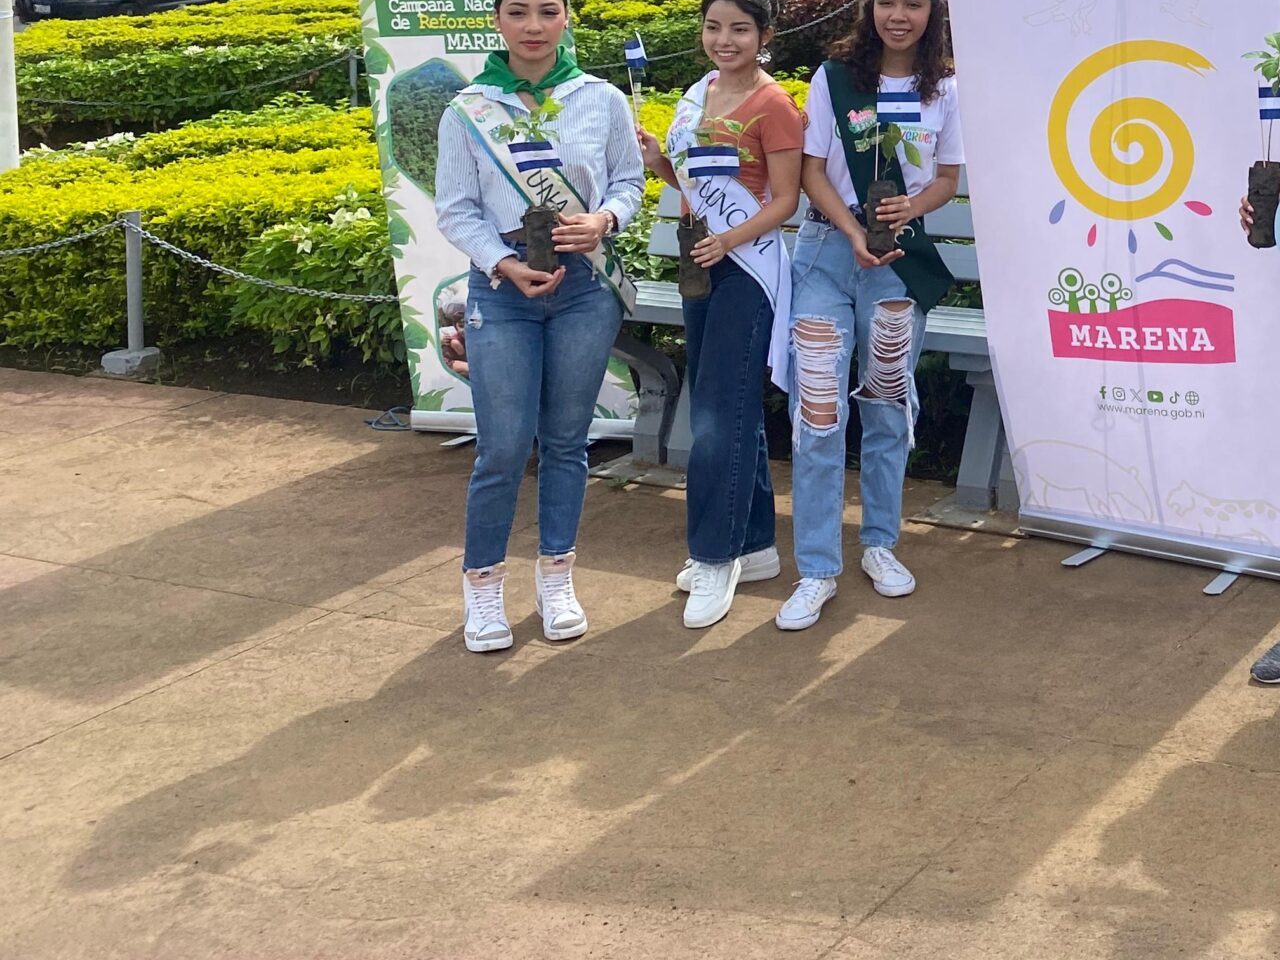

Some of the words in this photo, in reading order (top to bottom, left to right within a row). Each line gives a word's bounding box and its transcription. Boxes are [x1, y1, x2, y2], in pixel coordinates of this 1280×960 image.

[391, 14, 410, 30] de
[419, 14, 496, 30] Reforest
[446, 33, 509, 51] MAREN
[1069, 324, 1215, 352] MARENA
[1097, 401, 1206, 421] www.marena.gob.ni
